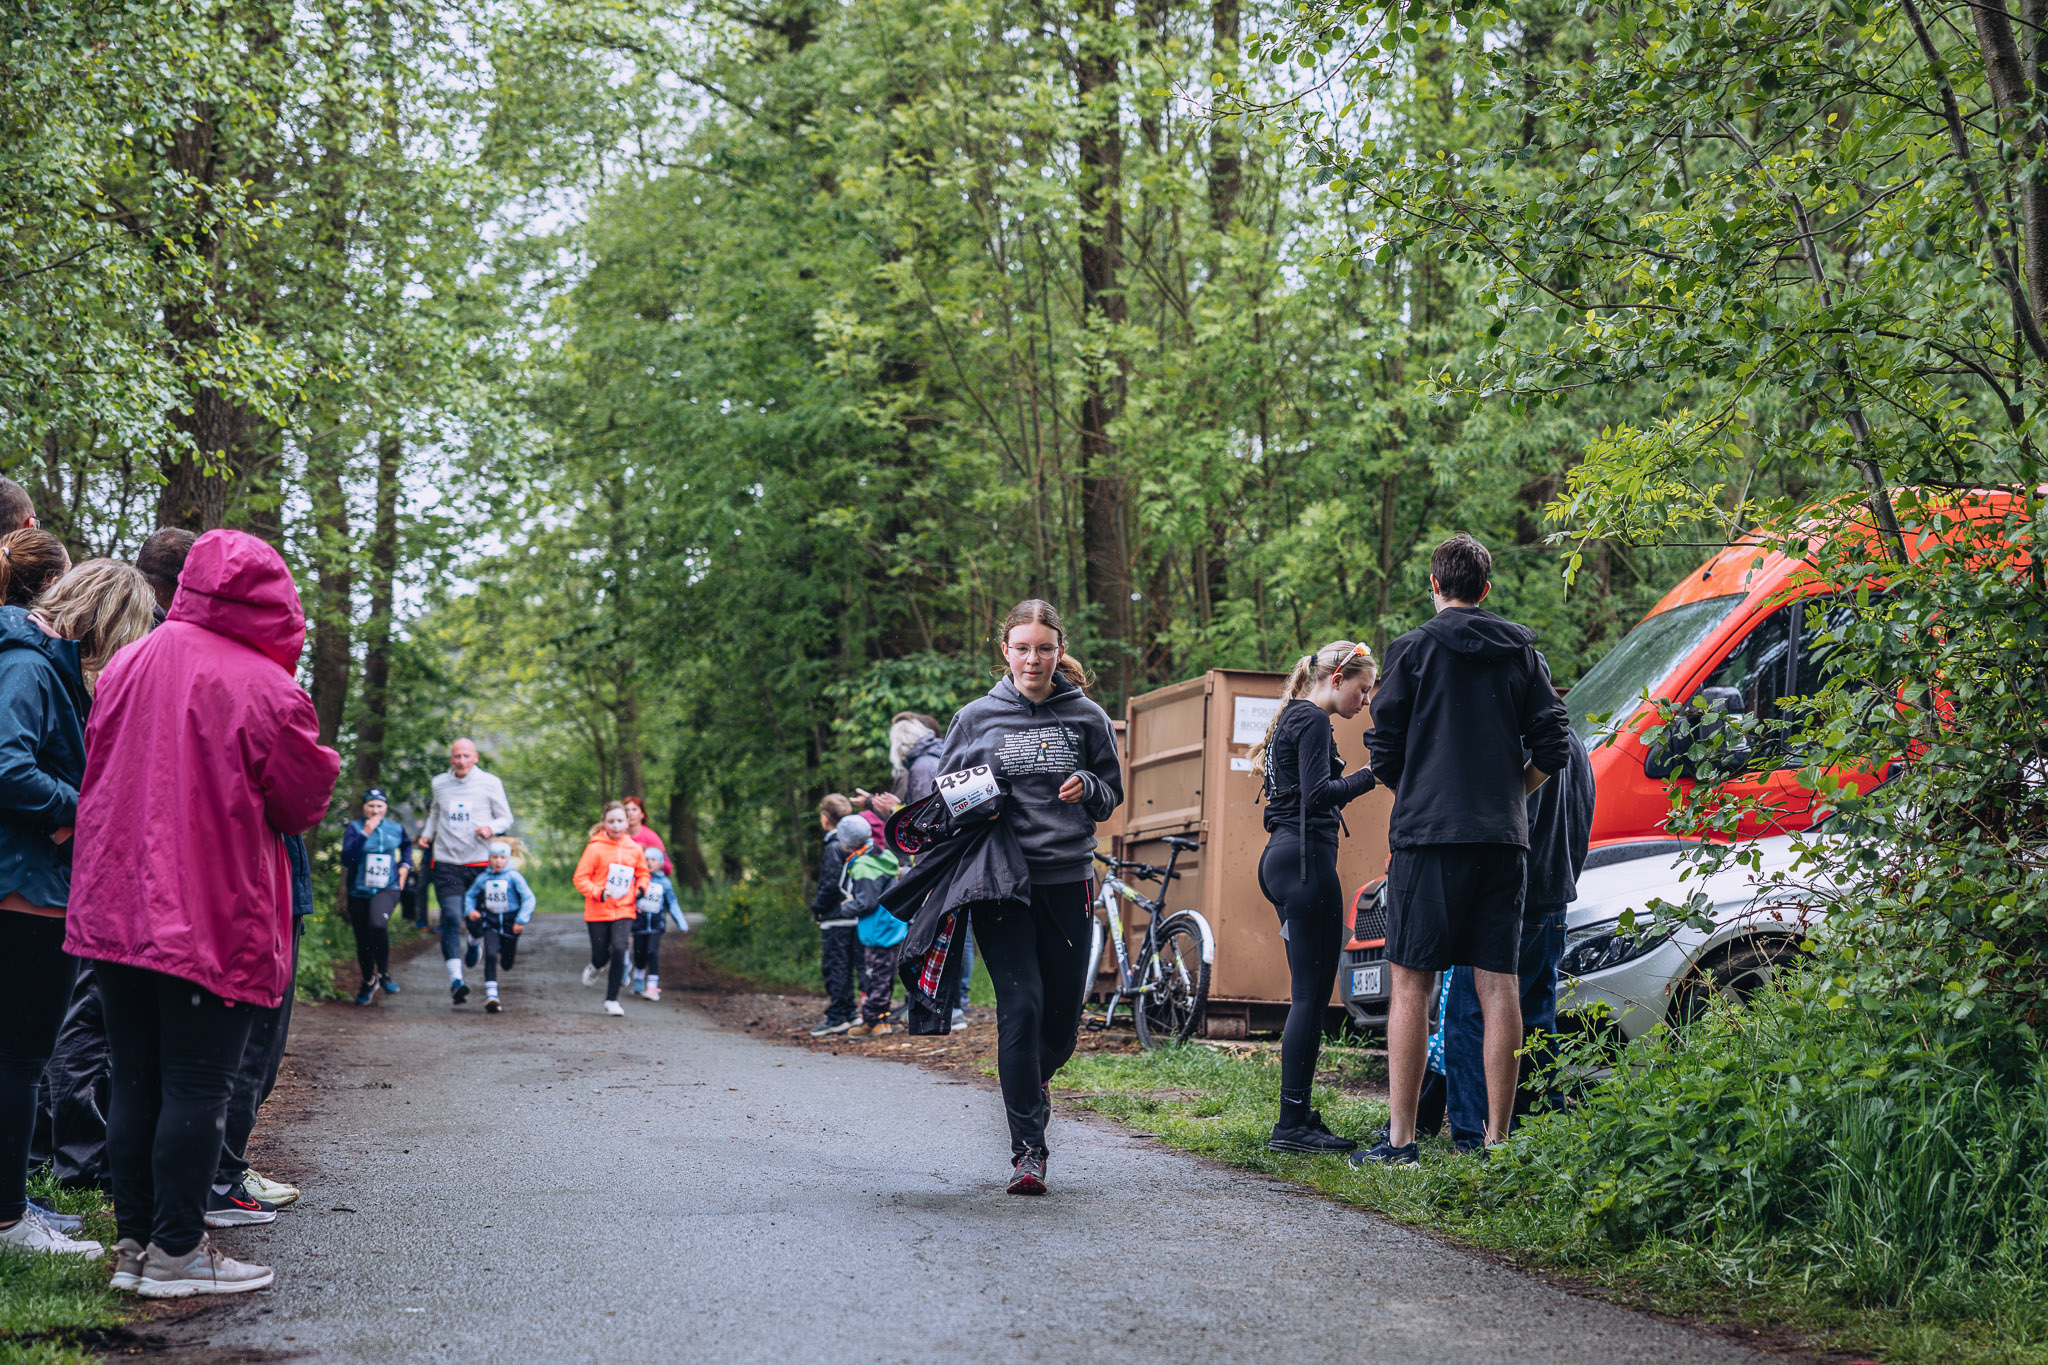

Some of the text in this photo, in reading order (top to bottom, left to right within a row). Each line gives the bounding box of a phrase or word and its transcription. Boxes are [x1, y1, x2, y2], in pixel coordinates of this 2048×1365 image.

[953, 801, 969, 813] CUP
[450, 812, 470, 823] 481
[609, 876, 629, 888] 431
[487, 892, 507, 903] 483
